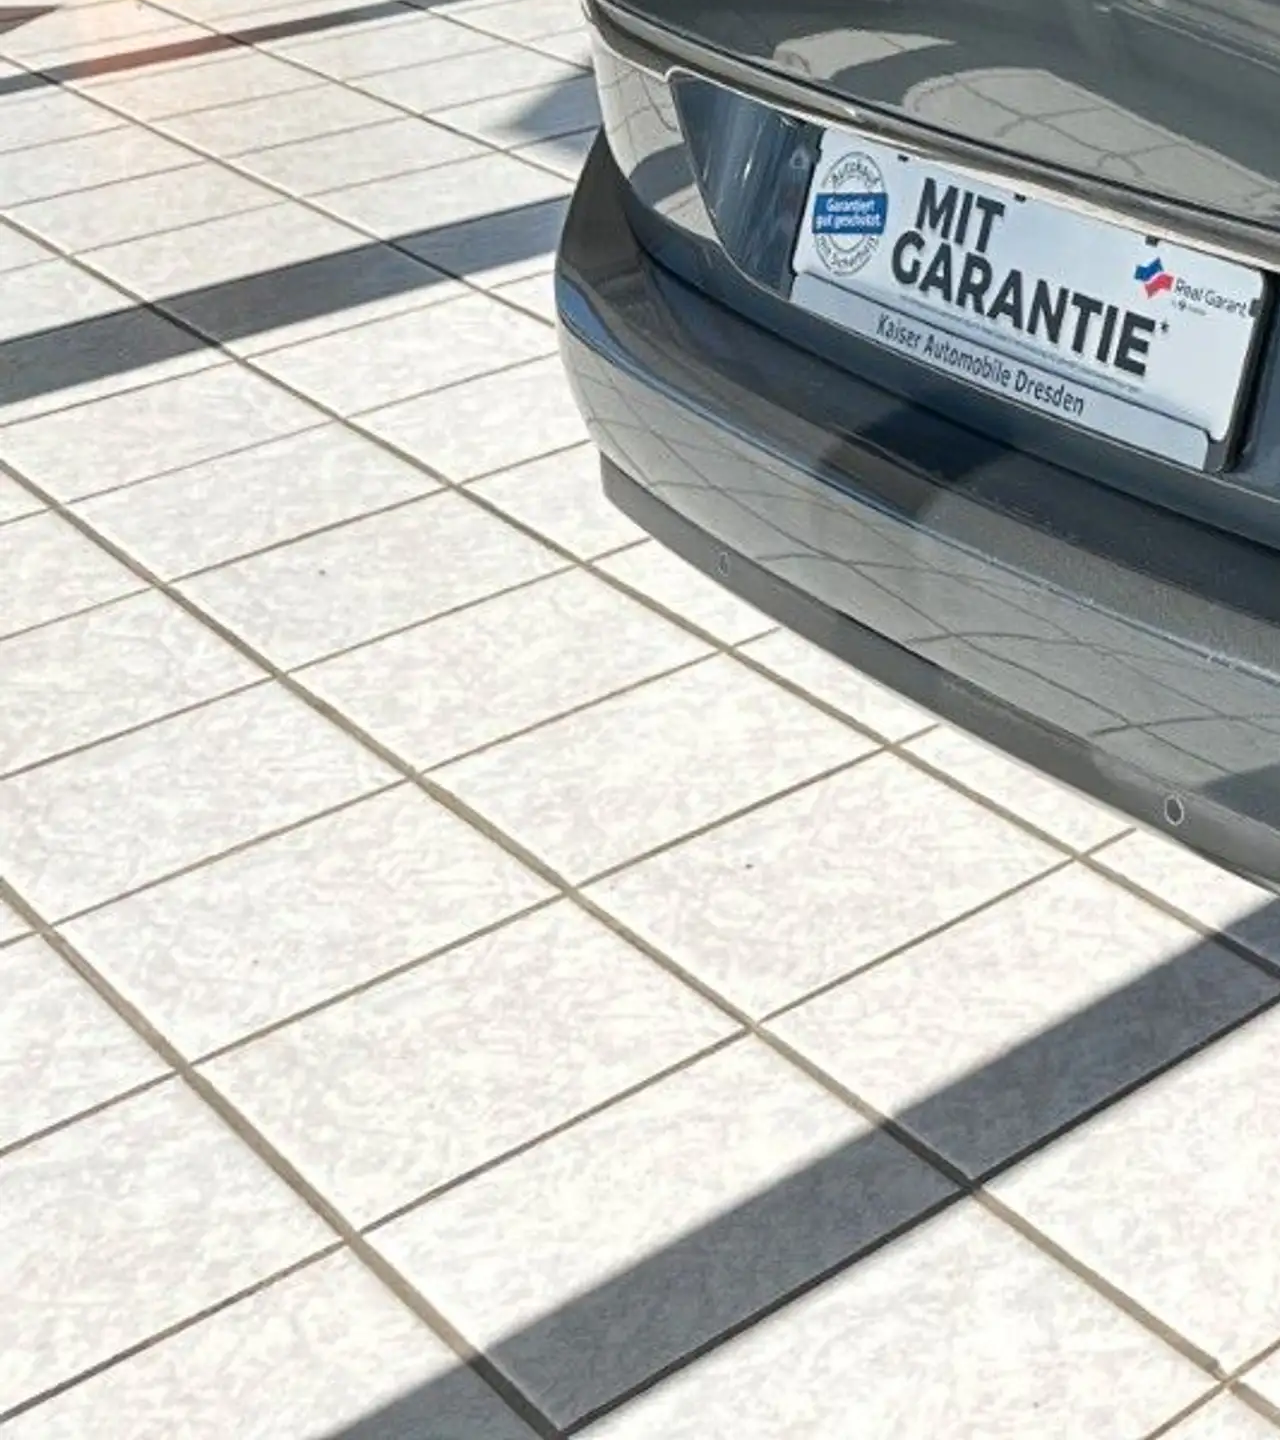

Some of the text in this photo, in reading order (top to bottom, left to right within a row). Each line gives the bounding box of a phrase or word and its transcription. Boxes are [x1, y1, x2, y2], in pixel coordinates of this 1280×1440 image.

[916, 177, 1005, 253] MIT
[1174, 278, 1204, 302] Real
[1204, 288, 1248, 317] Garant
[876, 312, 922, 349] Kaiser
[923, 333, 1011, 389] Automobile
[1014, 368, 1085, 416] Dresden
